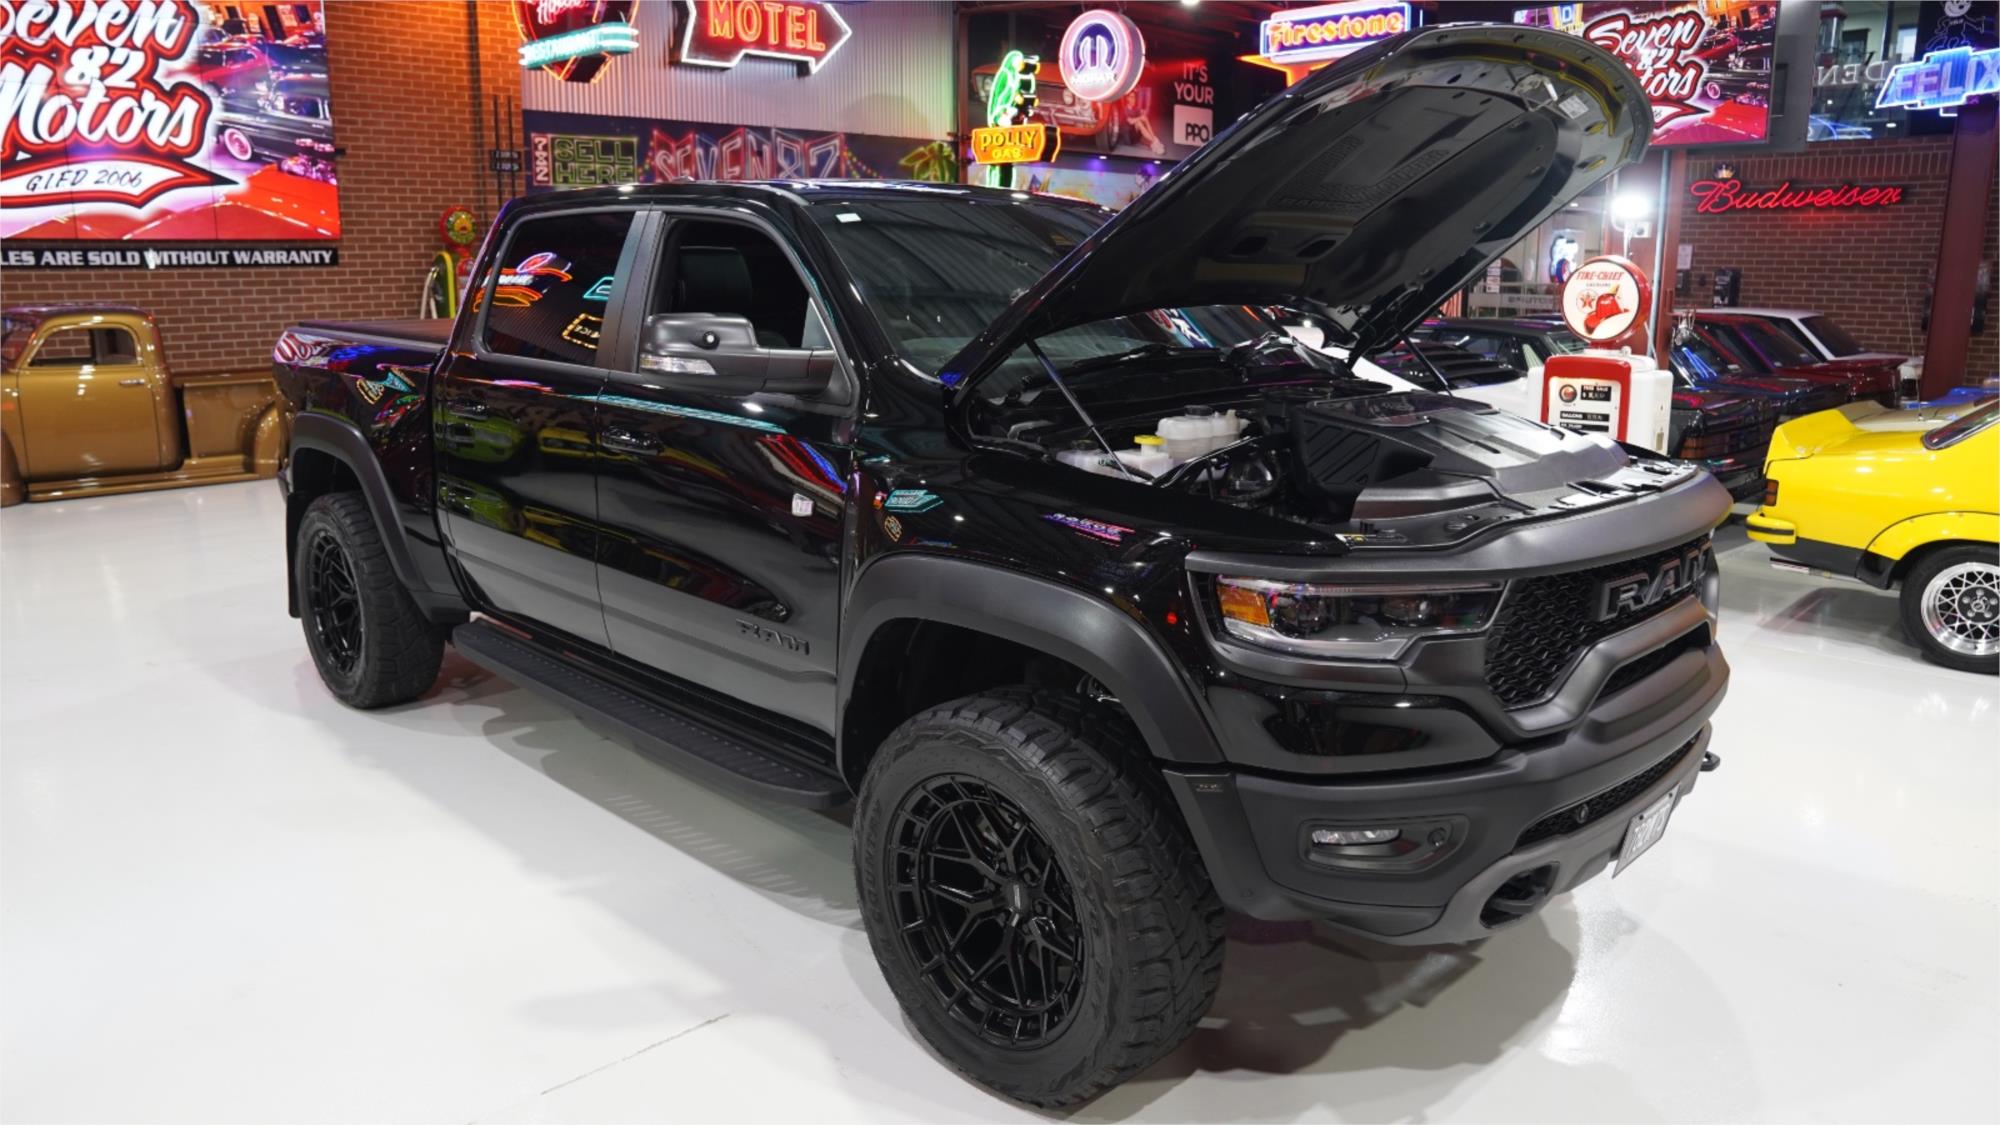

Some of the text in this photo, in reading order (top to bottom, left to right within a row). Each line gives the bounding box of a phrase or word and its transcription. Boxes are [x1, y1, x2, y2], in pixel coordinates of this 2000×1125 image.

[709, 0, 826, 51] MOTEL
[1269, 12, 1404, 51] Firestone
[1589, 18, 1697, 55] Seven
[63, 45, 145, 89] 82
[1183, 62, 1208, 83] IT'S
[1637, 48, 1673, 72] 82
[1895, 56, 2000, 101] FELIX
[1174, 82, 1214, 105] YOUR
[554, 138, 633, 164] SELL
[980, 130, 1037, 152] POLLY
[991, 147, 1025, 159] GAS
[94, 169, 143, 188] 2006
[555, 162, 634, 185] HERE
[1690, 179, 1902, 214] Budweiser
[40, 251, 84, 266] ARE
[87, 251, 140, 266] SOLD
[143, 250, 229, 265] WITHOUT
[233, 250, 332, 265] WARRANTY
[1576, 271, 1625, 280] FIRE-CHIEF
[1600, 540, 1712, 620] RAM
[736, 618, 809, 655] RAM
